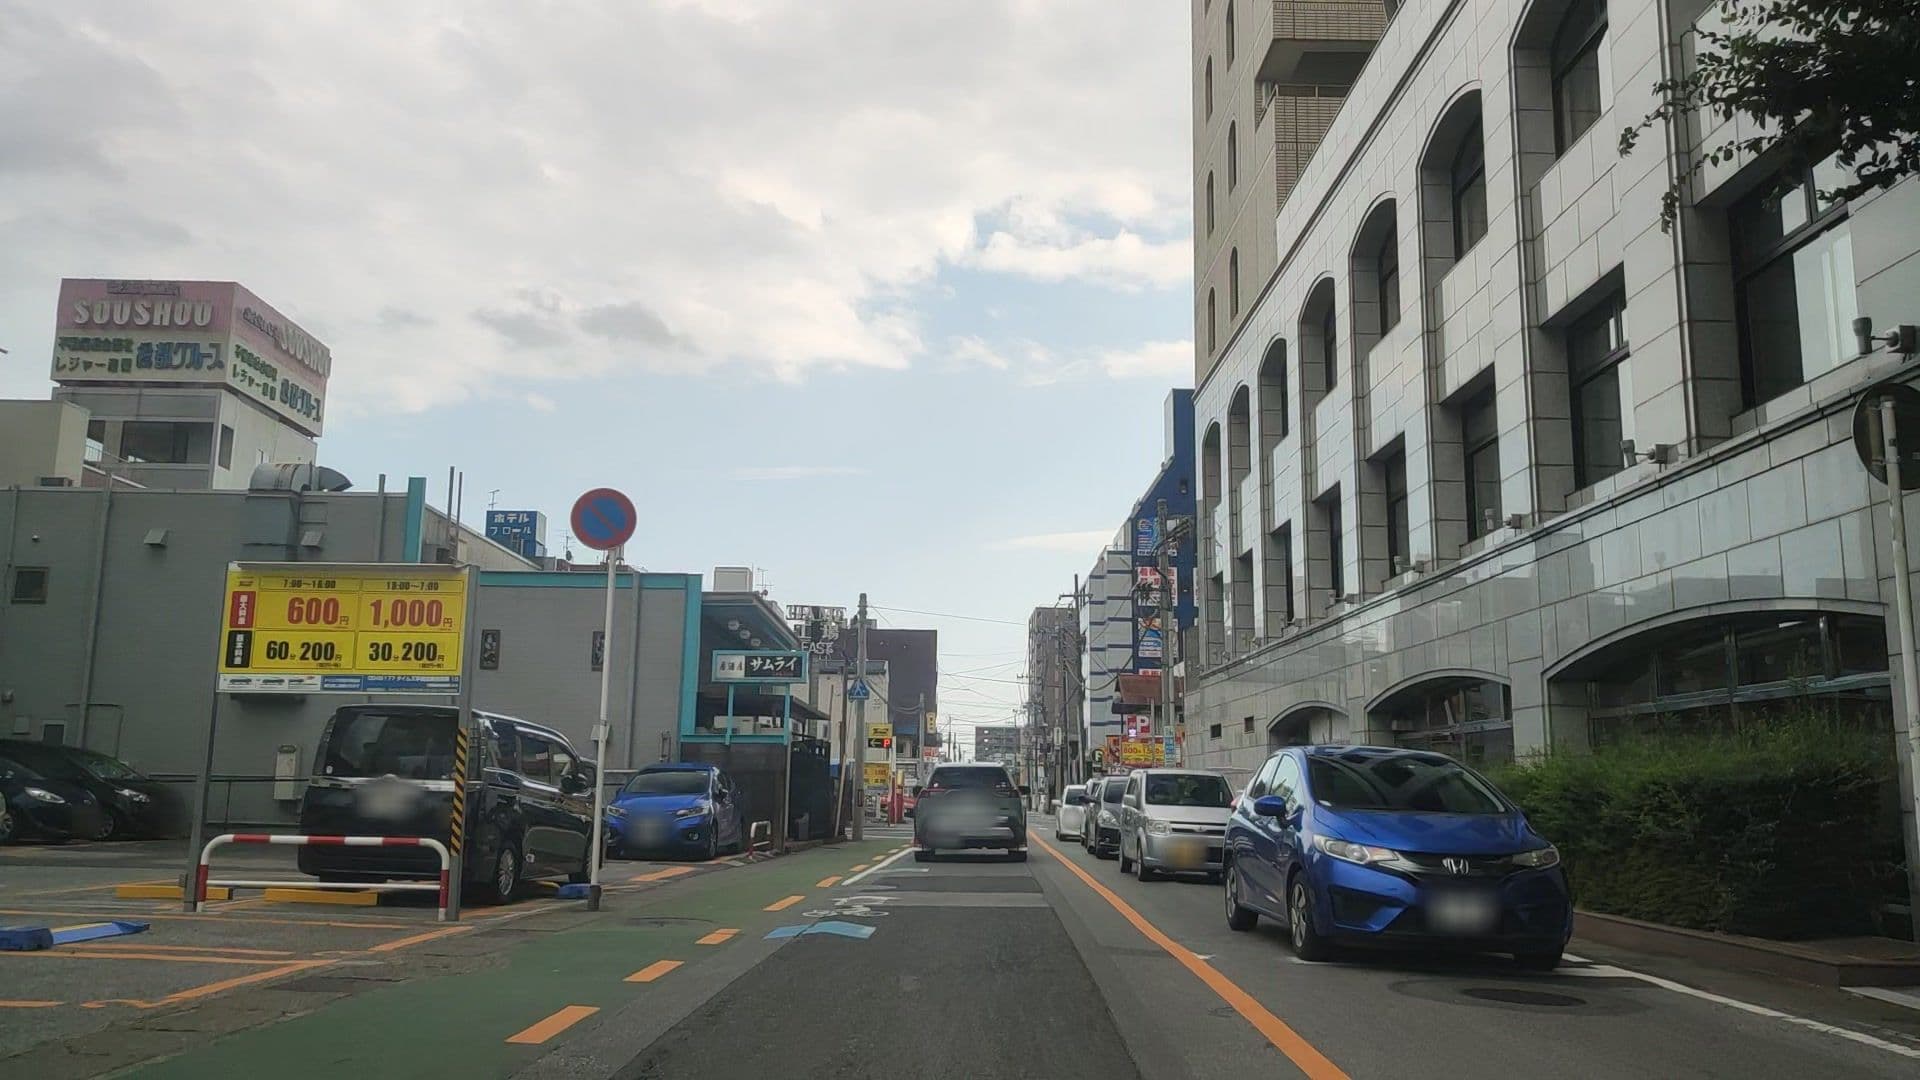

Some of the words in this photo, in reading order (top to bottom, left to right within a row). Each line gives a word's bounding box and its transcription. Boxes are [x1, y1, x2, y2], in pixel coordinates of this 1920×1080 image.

[73, 299, 214, 327] SOUSHOU
[494, 512, 530, 523] ホテル
[489, 526, 531, 536] フロール
[287, 597, 350, 626] 600円
[370, 599, 453, 628] 1,000円
[749, 657, 797, 671] サムライ
[883, 739, 891, 748] P
